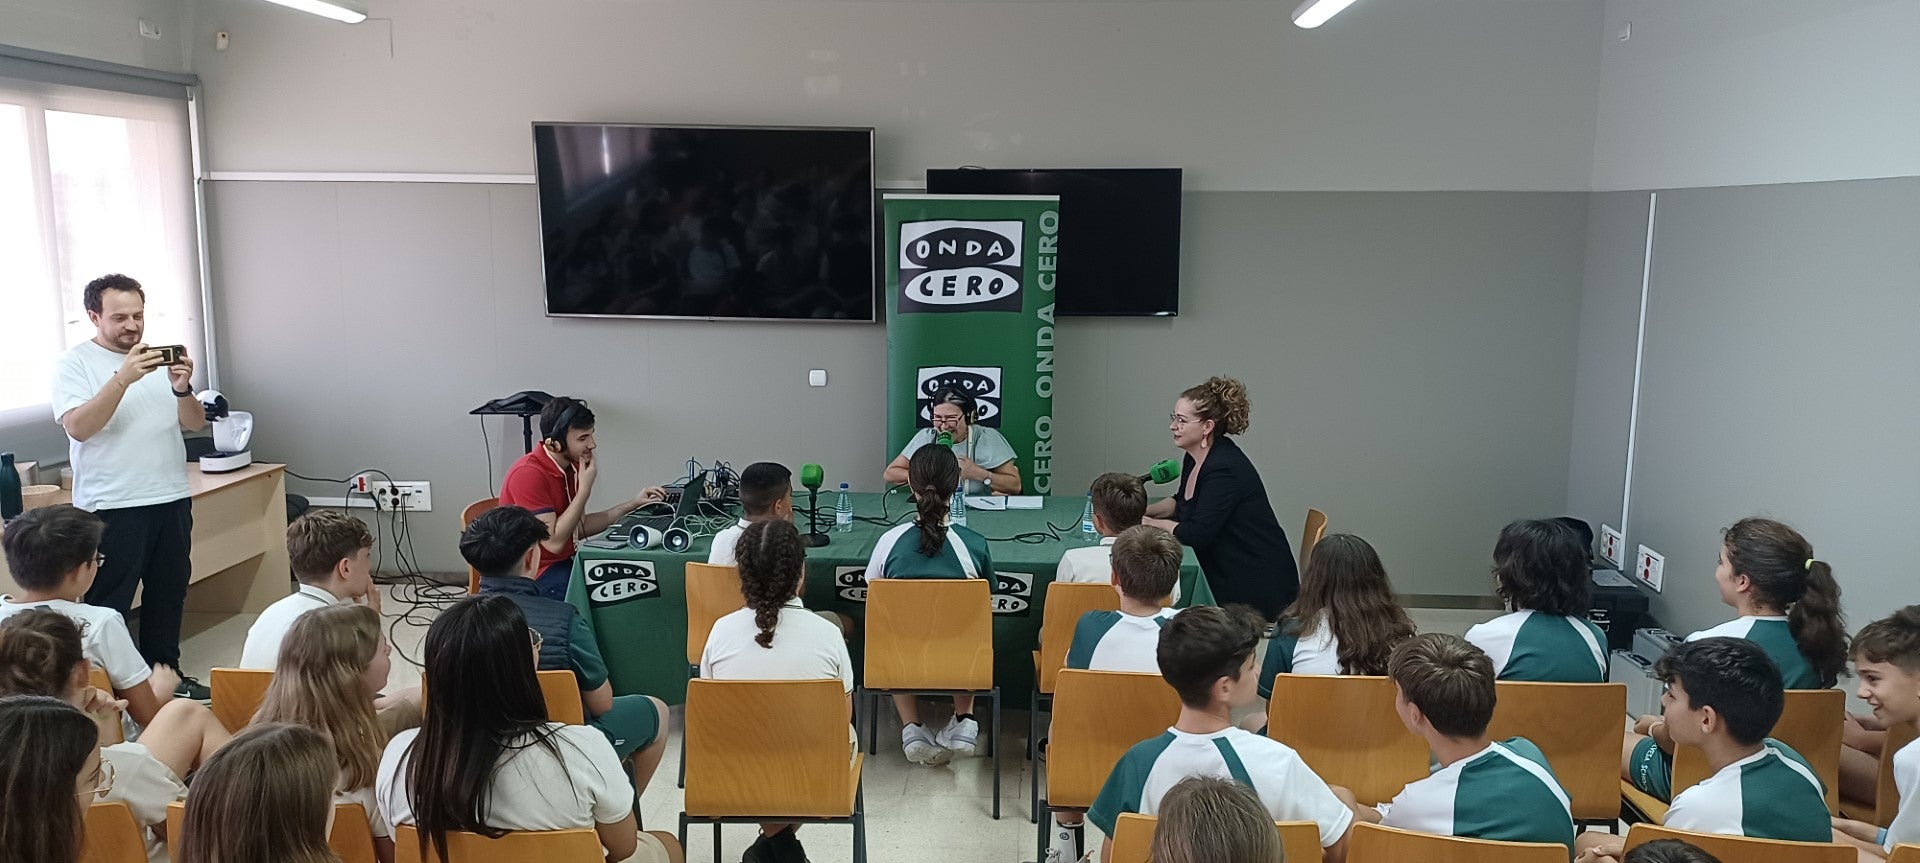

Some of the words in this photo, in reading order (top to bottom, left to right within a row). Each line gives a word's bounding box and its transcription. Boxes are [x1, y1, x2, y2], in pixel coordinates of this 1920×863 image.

[916, 239, 1004, 259] ONDA
[1037, 210, 1059, 291] CERO
[919, 274, 1004, 297] CERO
[1036, 302, 1056, 398] ONDA
[1033, 415, 1052, 494] CERO
[593, 566, 646, 577] ONDA
[844, 573, 866, 583] ON
[600, 582, 649, 598] CERO
[847, 589, 867, 599] CE
[998, 581, 1021, 591] DA
[997, 598, 1020, 610] RO
